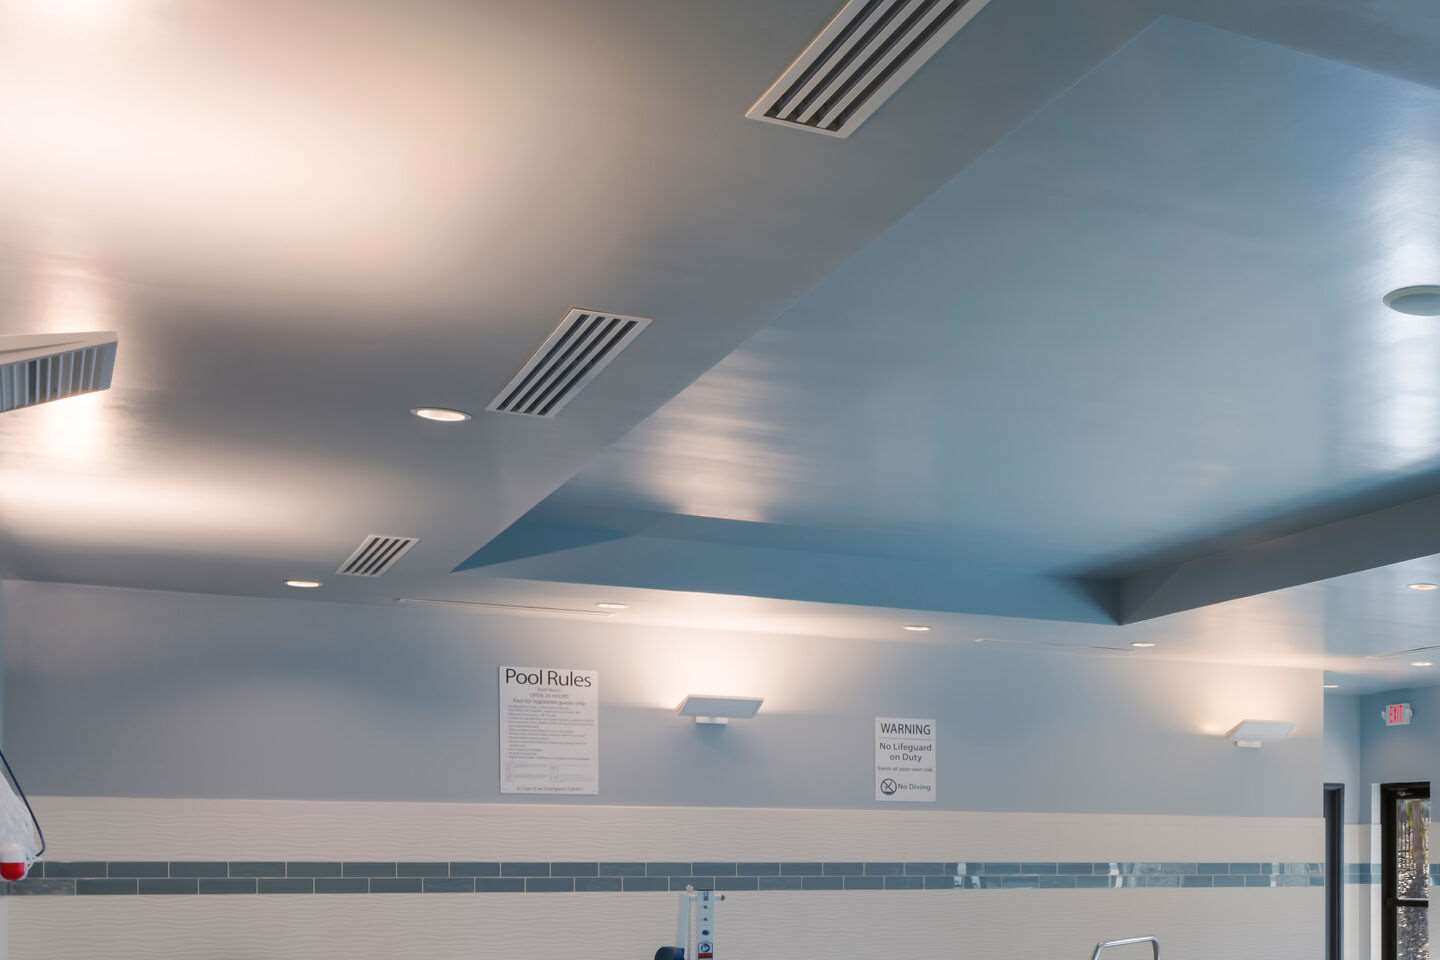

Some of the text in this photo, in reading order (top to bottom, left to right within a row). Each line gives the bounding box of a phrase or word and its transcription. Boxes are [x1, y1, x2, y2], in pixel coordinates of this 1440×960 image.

[505, 668, 592, 687] Pool Rules
[880, 723, 931, 735] WARNING
[880, 742, 932, 752] No Lifeguard
[902, 753, 922, 762] Duty
